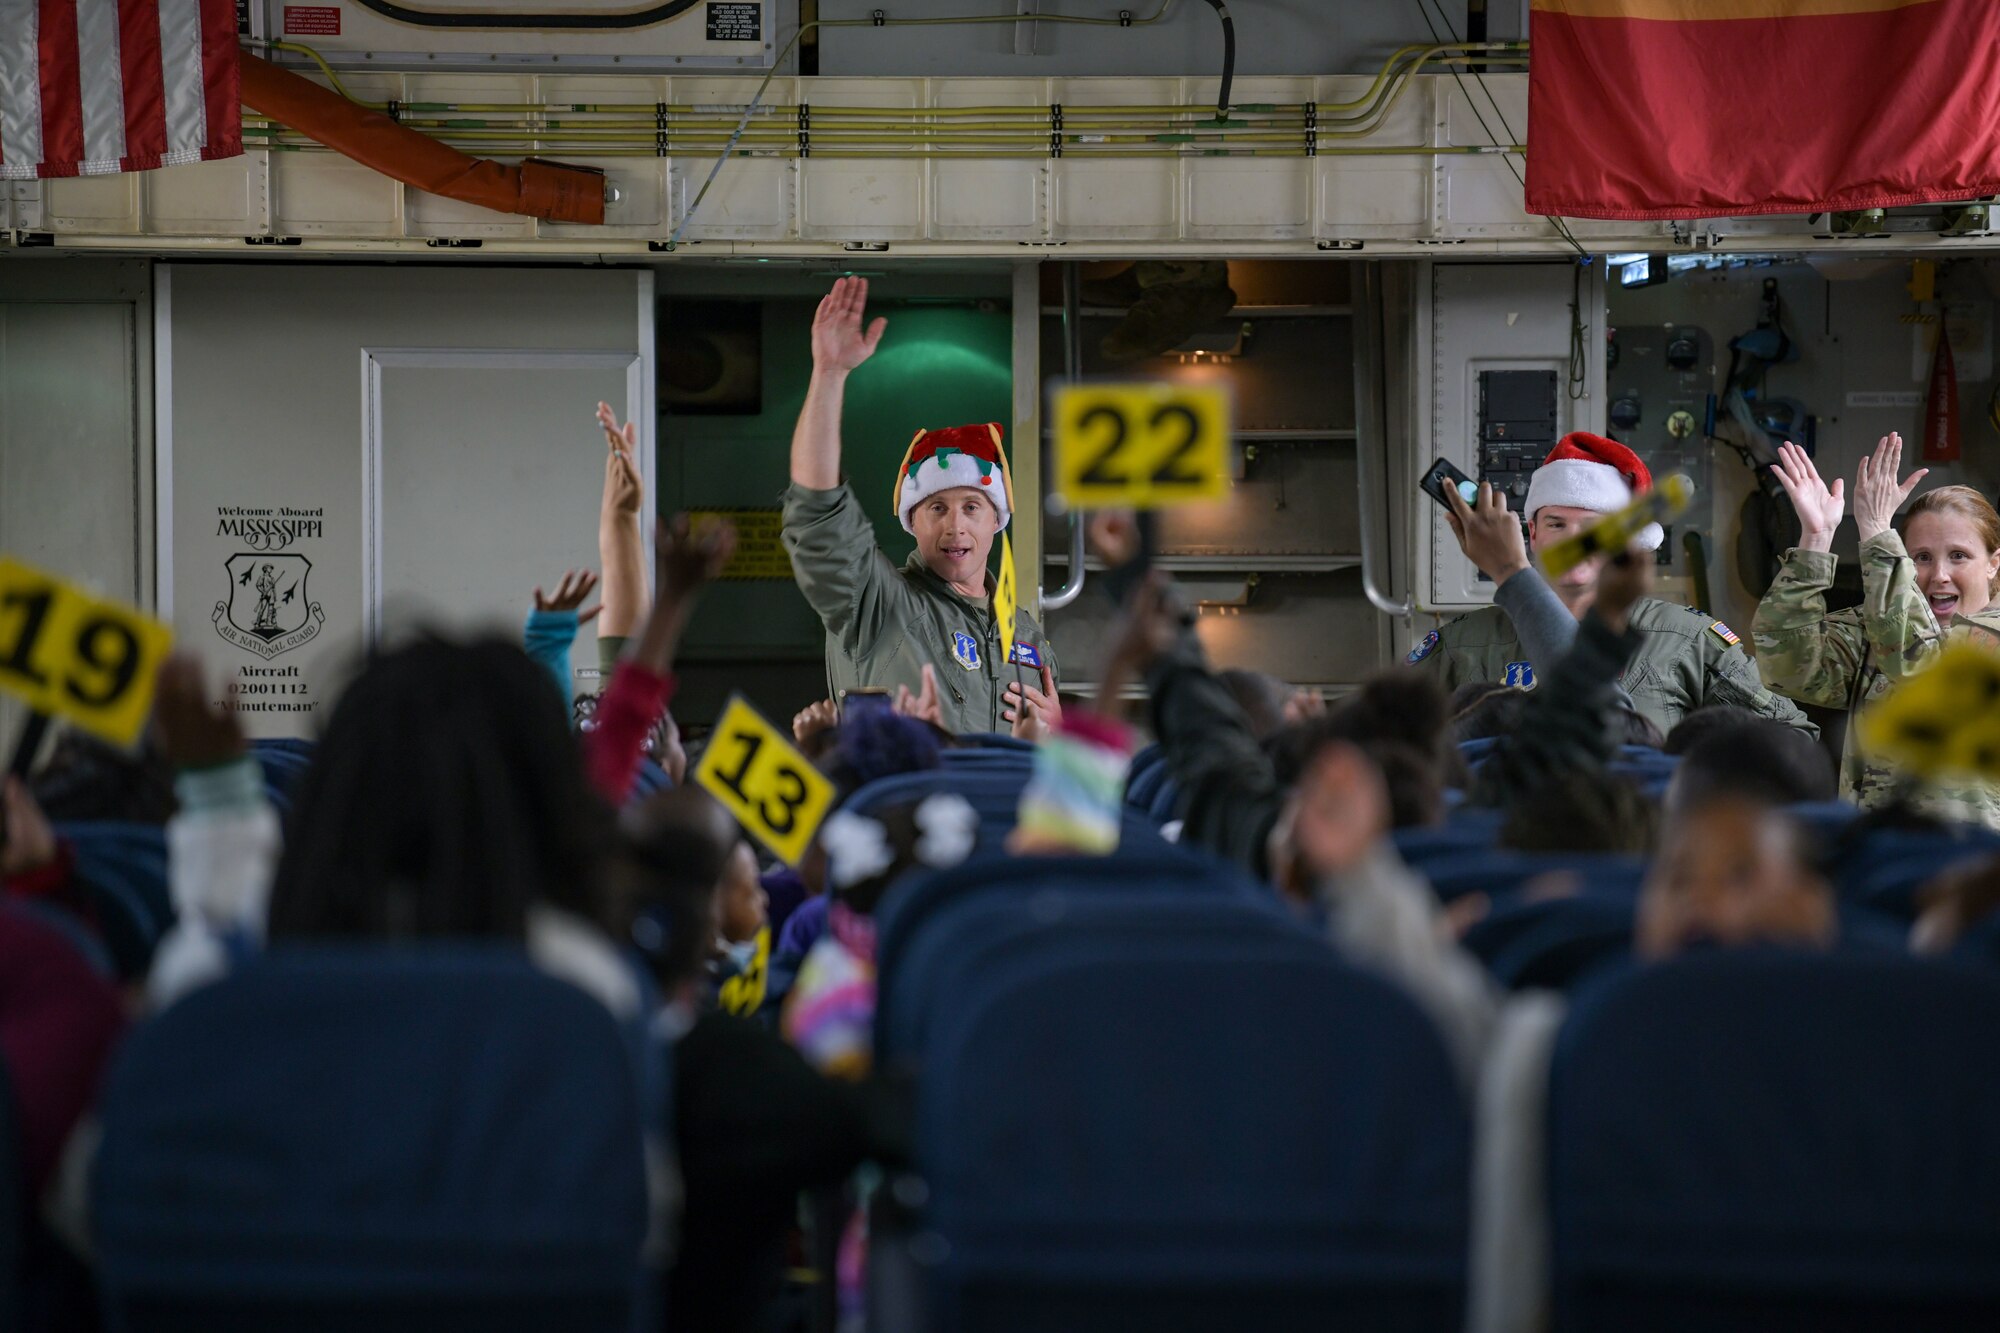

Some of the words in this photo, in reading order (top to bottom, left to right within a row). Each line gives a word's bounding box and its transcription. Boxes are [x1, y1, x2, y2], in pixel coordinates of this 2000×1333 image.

[1077, 404, 1204, 486] 22
[218, 506, 273, 516] Welcome
[277, 507, 323, 516] Aboard
[216, 518, 322, 550] MISSISSIPPI
[0, 584, 141, 707] 19
[221, 626, 237, 640] AIR
[239, 636, 285, 656] NATIONAL
[287, 625, 316, 646] GUARD
[238, 665, 299, 676] Aircraft
[228, 684, 307, 694] 02001112
[714, 731, 808, 834] 13
